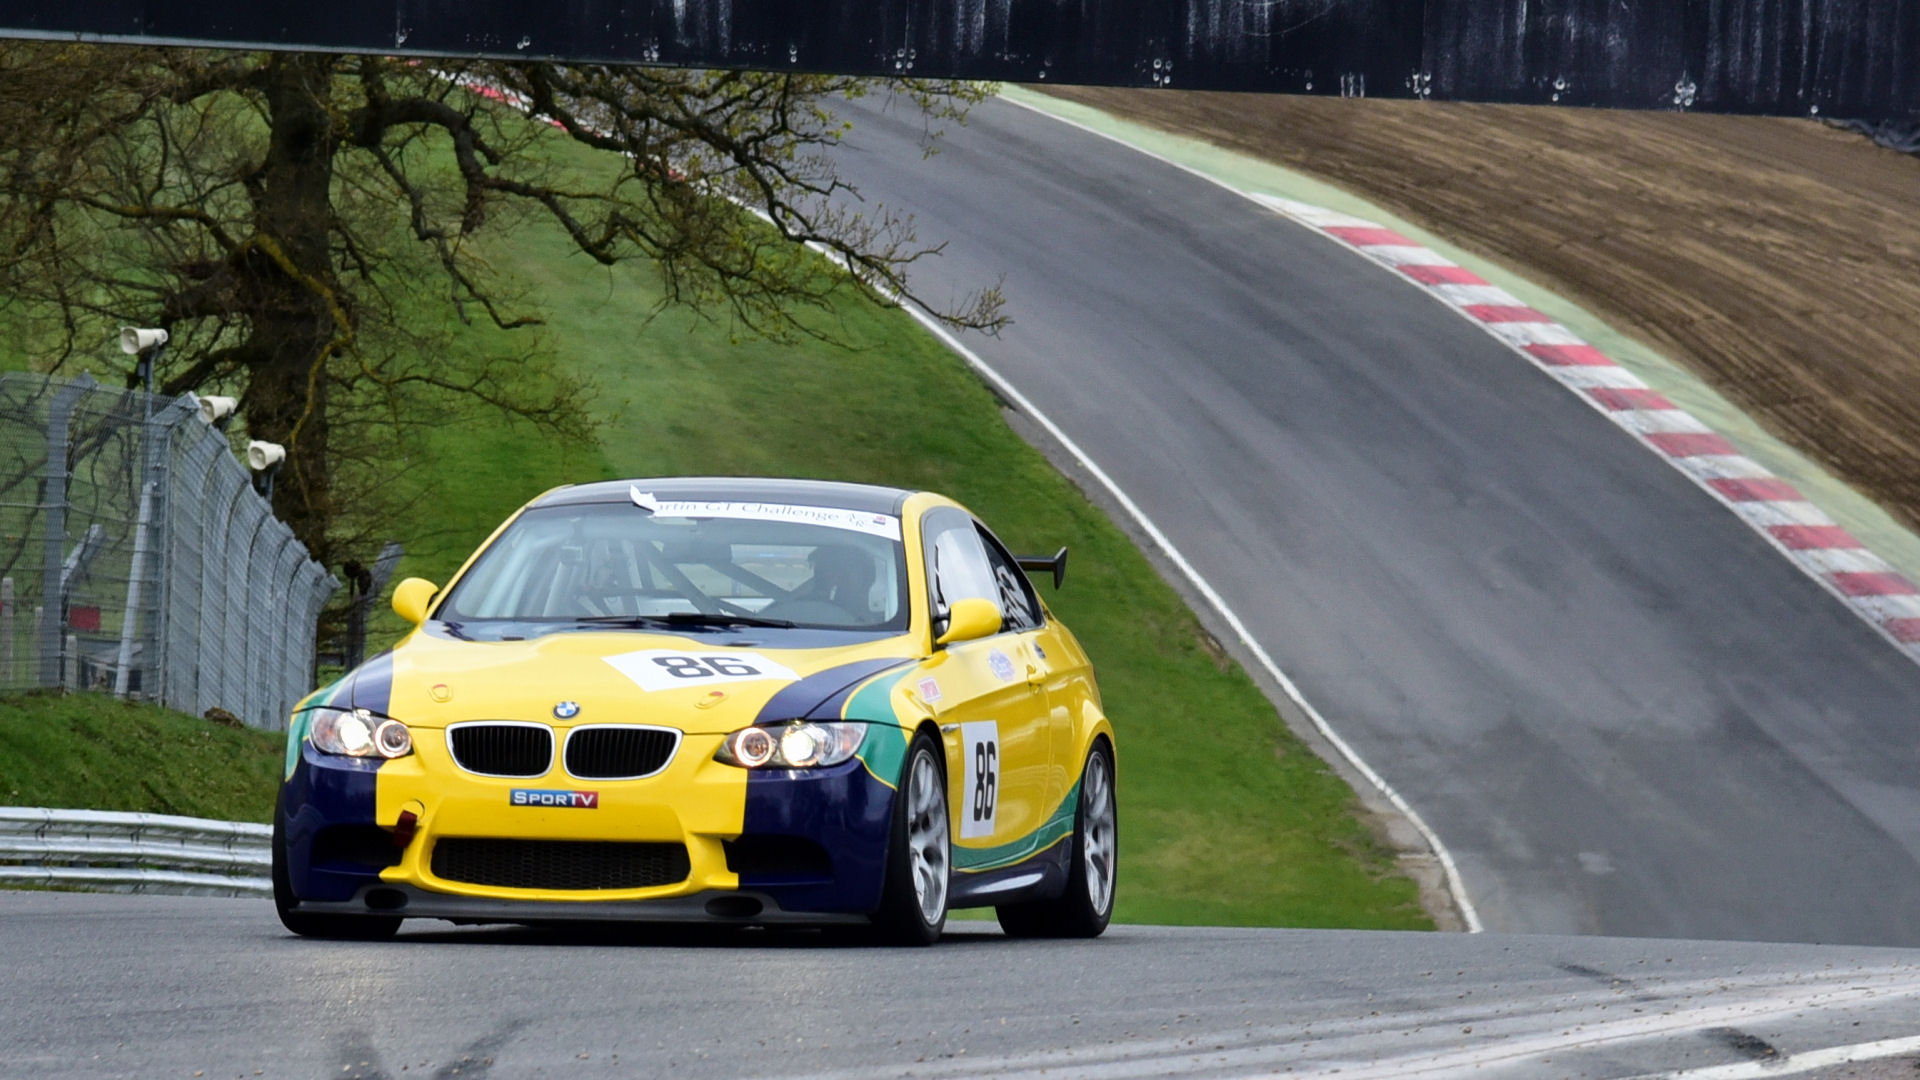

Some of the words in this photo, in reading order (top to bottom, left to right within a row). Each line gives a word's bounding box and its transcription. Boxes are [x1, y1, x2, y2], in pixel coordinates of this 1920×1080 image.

[657, 502, 698, 512] artin
[704, 501, 733, 513] GT
[741, 502, 841, 521] Challenge
[651, 656, 763, 679] 86
[973, 741, 996, 822] 86
